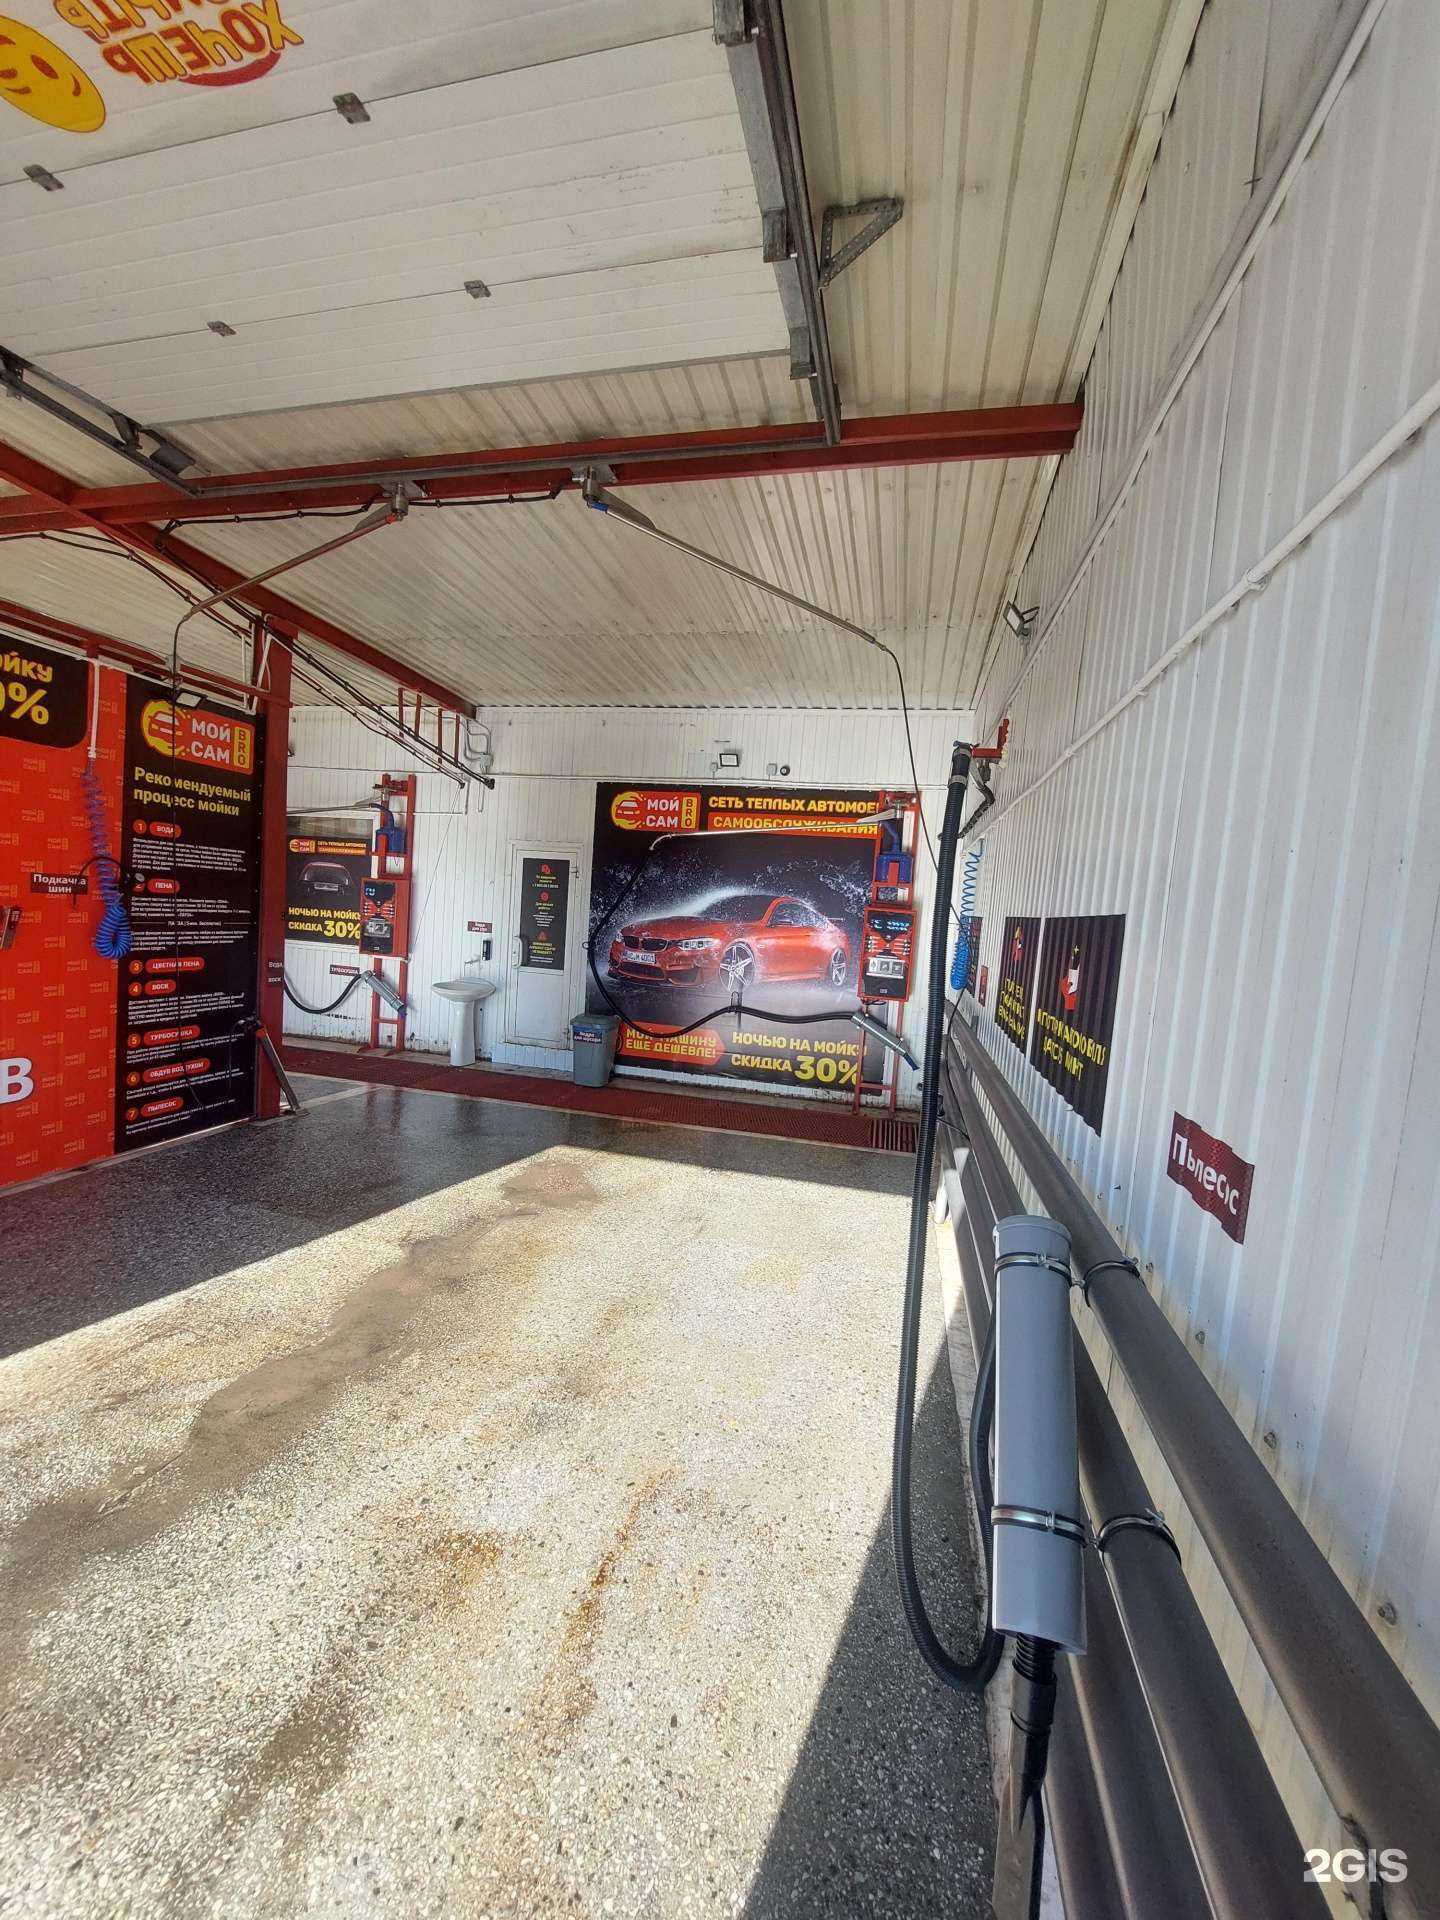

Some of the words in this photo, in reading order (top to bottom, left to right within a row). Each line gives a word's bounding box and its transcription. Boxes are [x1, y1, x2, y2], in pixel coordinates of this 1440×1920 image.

[102, 0, 305, 84] ХОЧЕШЬ
[0, 651, 53, 683] ЙКУ
[191, 717, 231, 743] МОЙ
[190, 741, 230, 764] САМ
[133, 788, 195, 808] процесс
[198, 800, 240, 816] мойки
[647, 796, 679, 812] МОЙ
[708, 796, 743, 808] СЕТЬ
[744, 797, 806, 811] ТЕПЛЫХ
[646, 815, 678, 828] САМ
[288, 907, 319, 917] НОЧЬЮ
[320, 909, 332, 917] НА
[288, 921, 322, 932] СКИДКА
[323, 920, 360, 939] 30%
[183, 960, 200, 968] ПЕНА
[131, 1036, 137, 1044] 5
[732, 1031, 786, 1049] НОЧЬЮ
[789, 1038, 810, 1052] НА
[653, 1043, 716, 1058] ДЕШЕВЛЕ!
[731, 1054, 792, 1072] СКИДКА
[794, 1055, 863, 1085] 30%
[130, 1110, 135, 1118] 7
